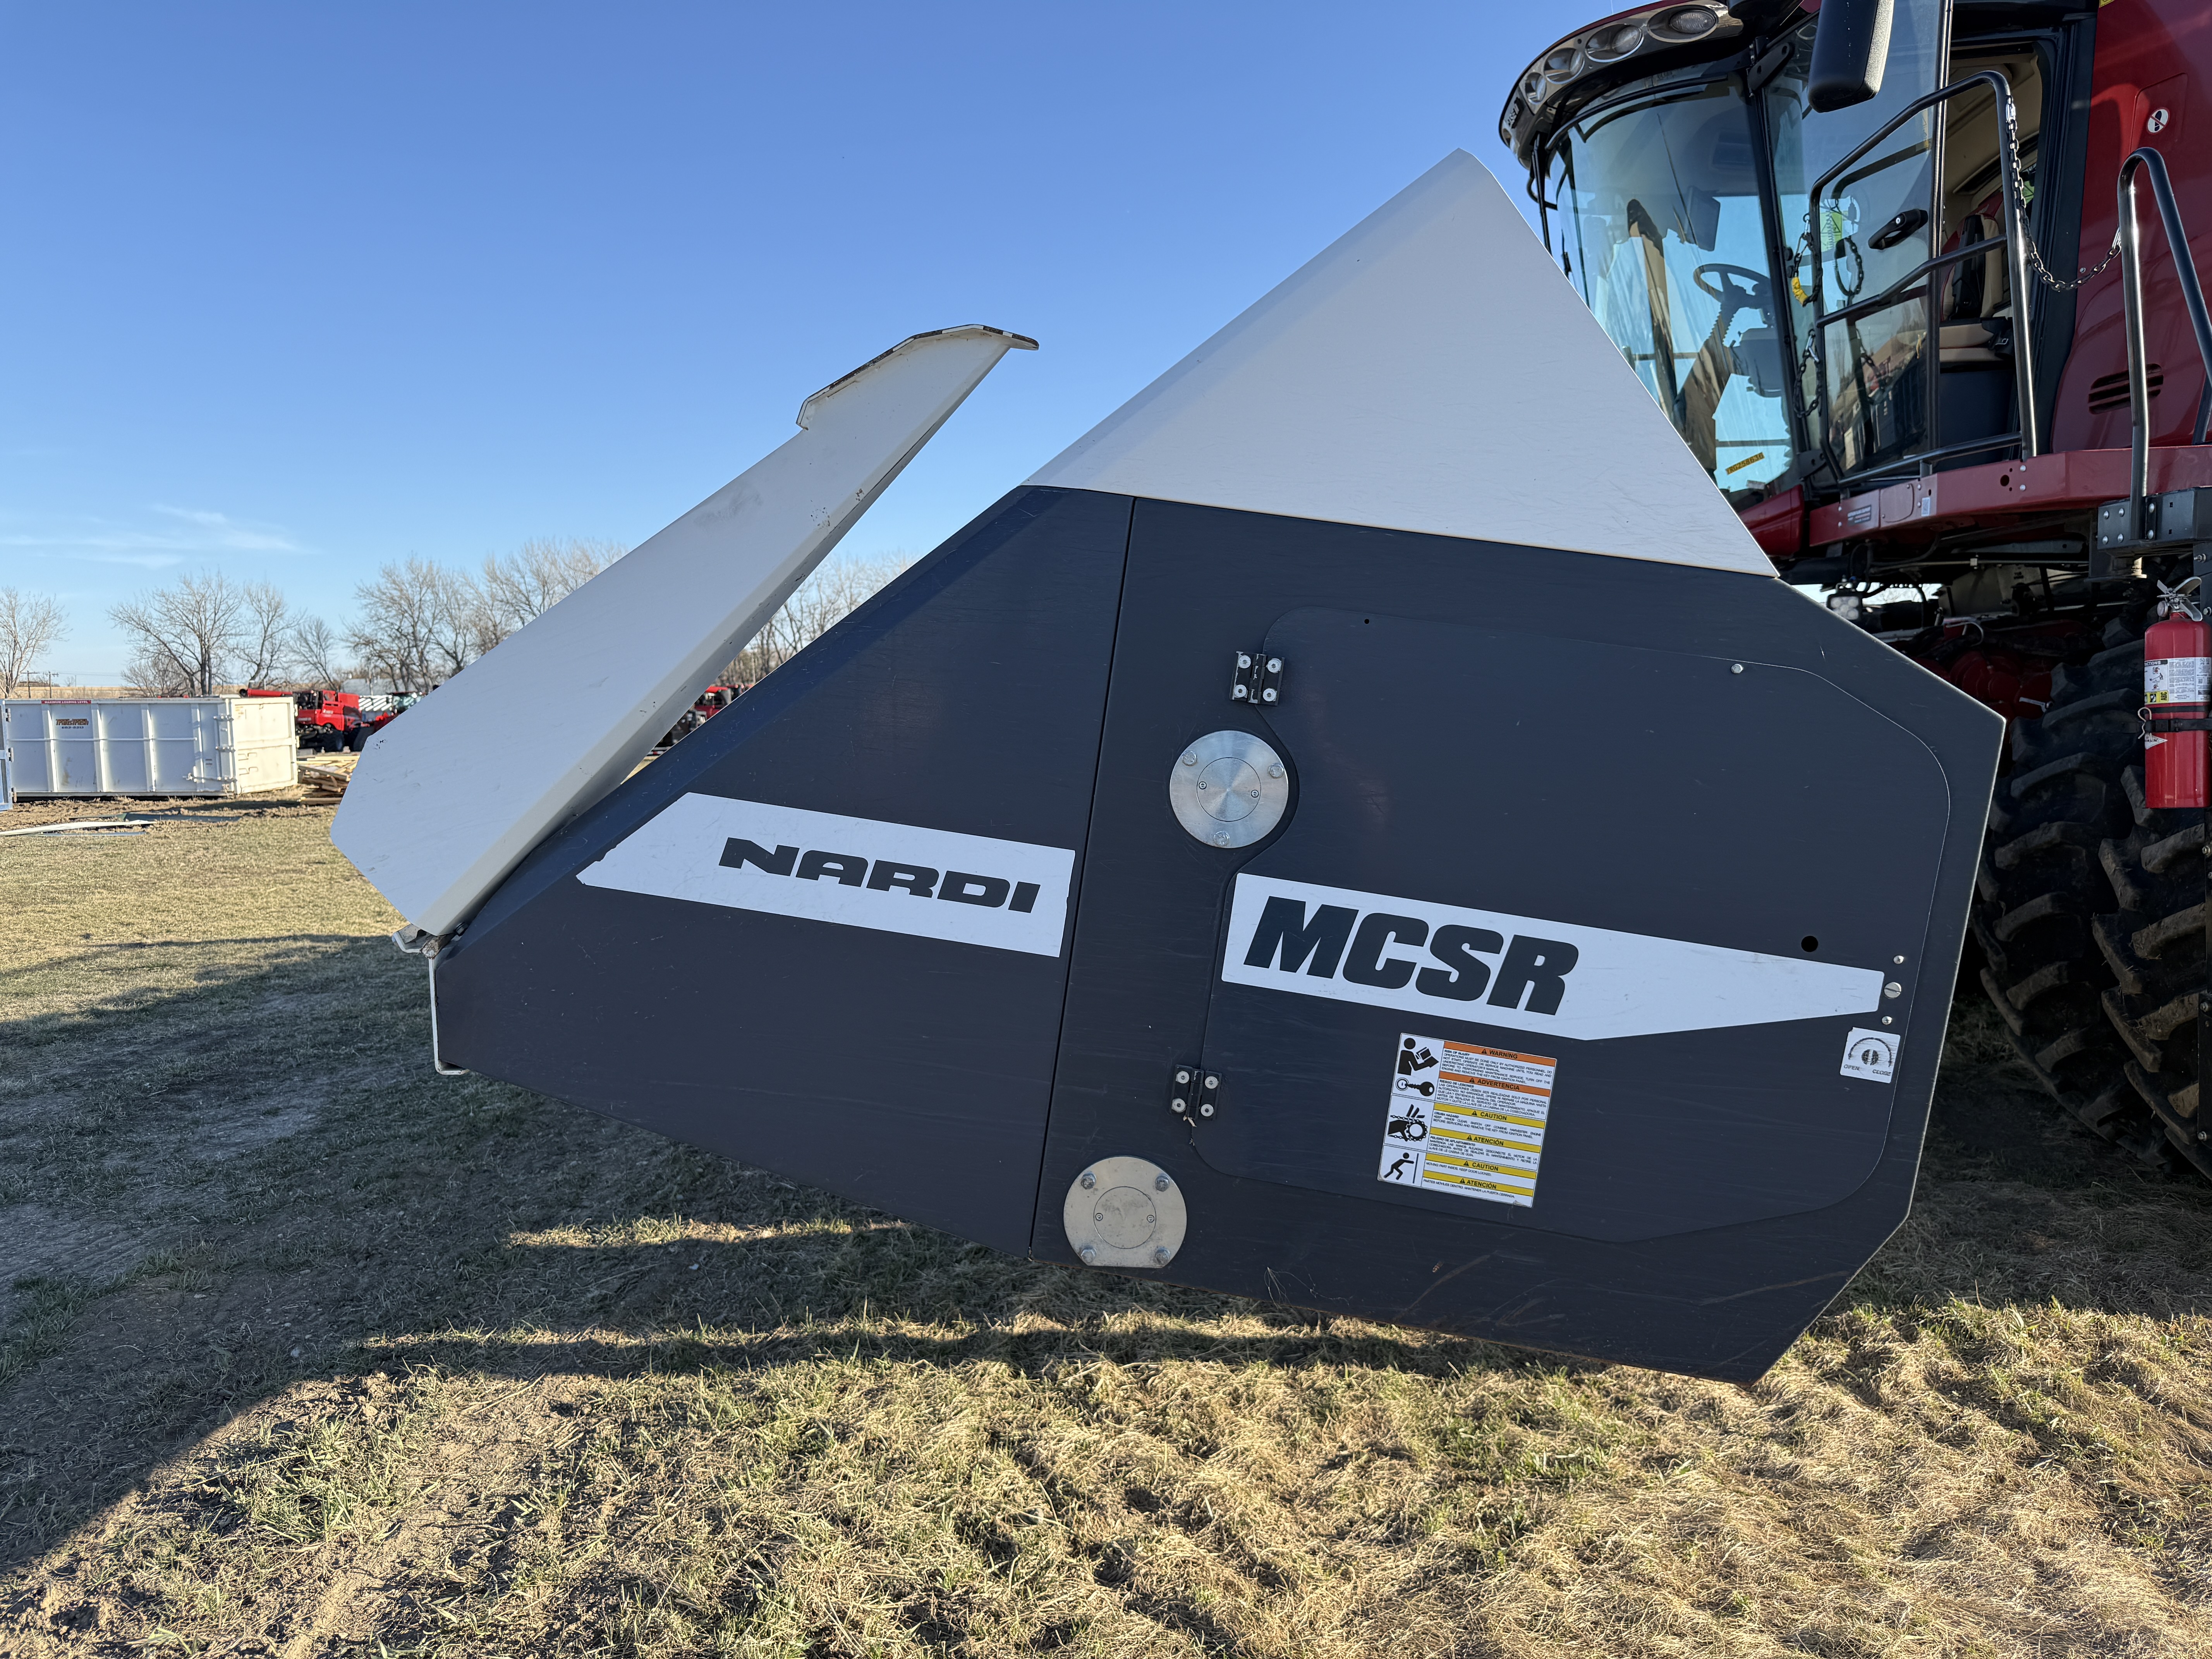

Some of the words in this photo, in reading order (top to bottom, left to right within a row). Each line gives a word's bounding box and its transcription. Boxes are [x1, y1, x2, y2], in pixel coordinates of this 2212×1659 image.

[719, 837, 1041, 913] NARDI
[1243, 896, 1578, 1015] MCSR
[1489, 1050, 1518, 1059] WARNING
[1477, 1079, 1520, 1091] ADVERTENCIA
[1480, 1111, 1507, 1121] CAUTION
[1473, 1135, 1504, 1146] ATENCIÓN
[1472, 1162, 1498, 1171] CAUTION
[1466, 1179, 1497, 1189] ATENCIÓN
